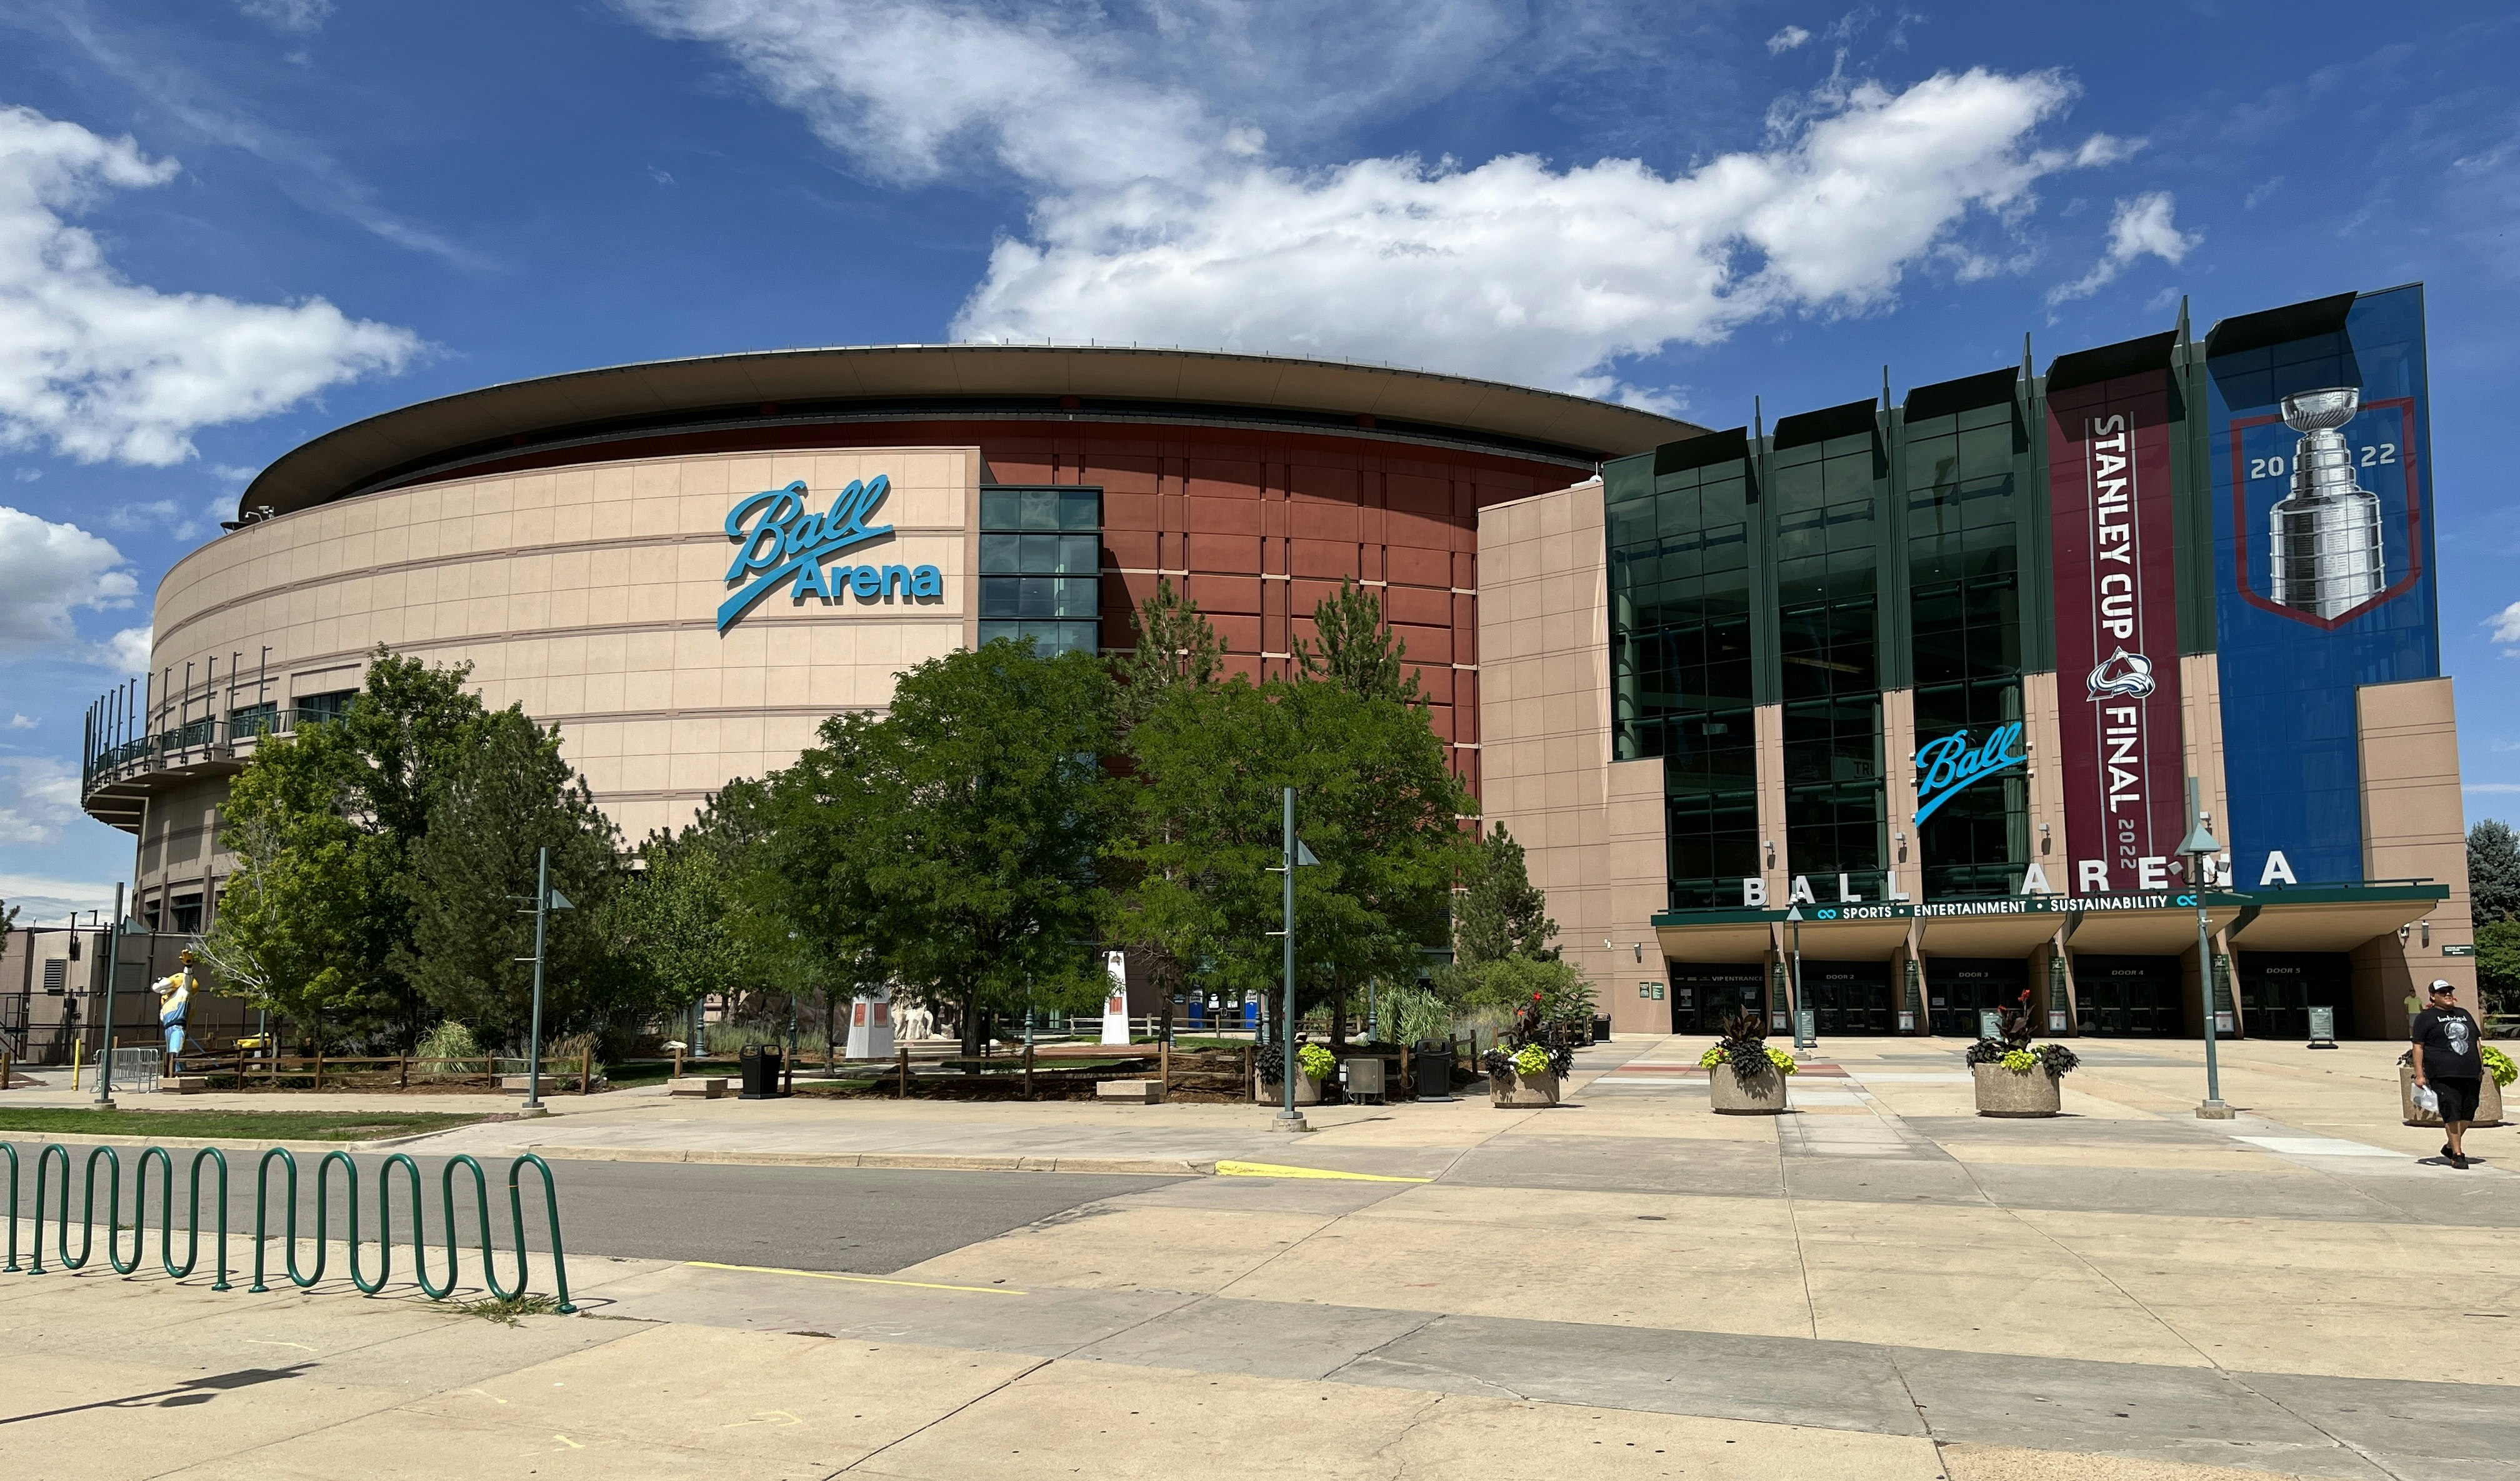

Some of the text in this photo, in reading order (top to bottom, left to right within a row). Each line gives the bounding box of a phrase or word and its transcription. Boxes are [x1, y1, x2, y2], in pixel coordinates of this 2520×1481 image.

[2251, 443, 2396, 479] 20 22
[718, 474, 893, 631] Ball
[790, 556, 941, 598] Arena
[2094, 414, 2140, 869] STANLEY CUP FINAL 2022
[1915, 721, 2028, 829] Ball
[1743, 850, 2298, 907] BALL ARENA
[1843, 895, 2168, 919] SPORTS ENTERTAINMENT SUSTAINABILITY
